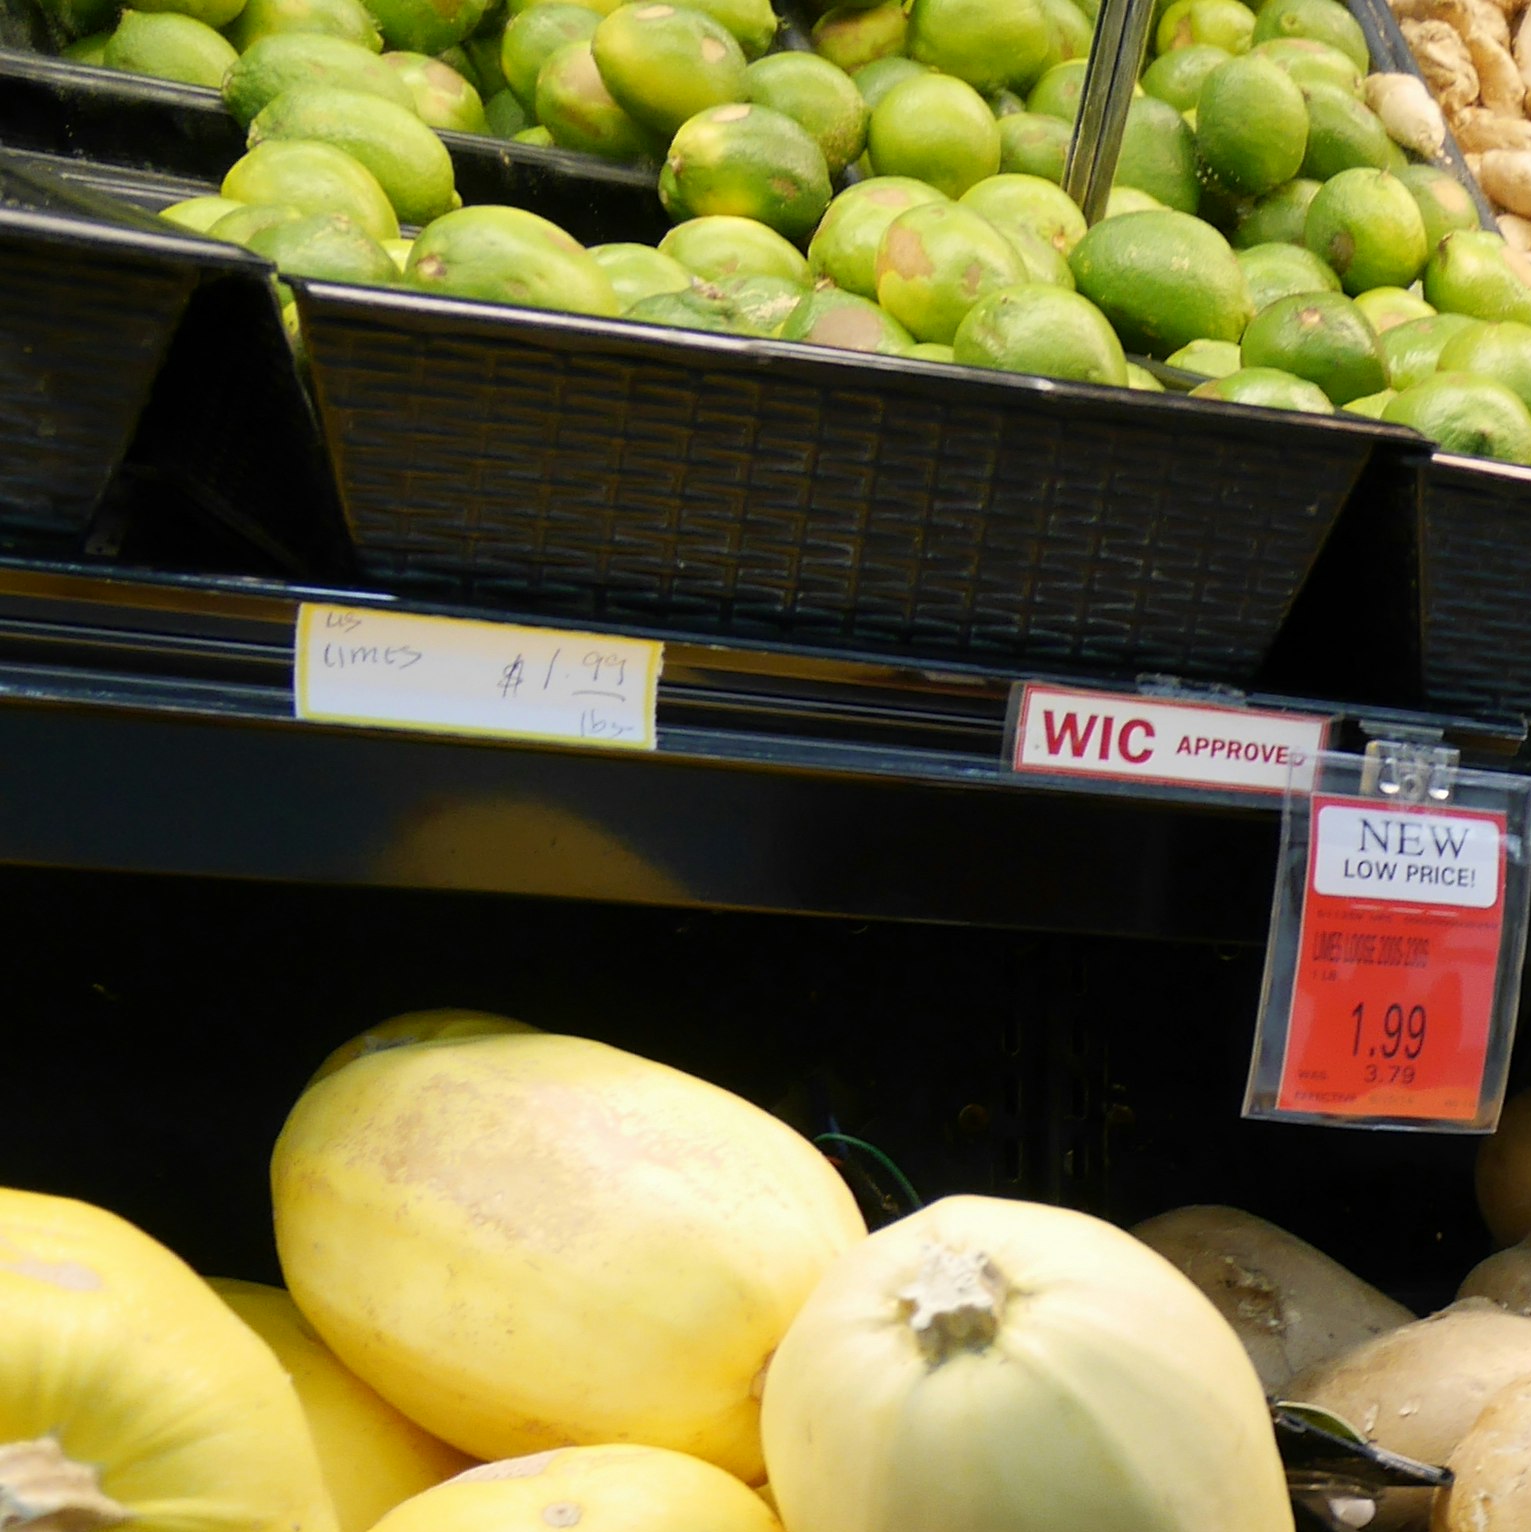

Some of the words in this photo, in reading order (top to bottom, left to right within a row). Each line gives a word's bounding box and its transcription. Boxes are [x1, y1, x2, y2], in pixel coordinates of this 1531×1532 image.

[1043, 710, 1155, 764] WIC
[1177, 736, 1308, 766] APPROVED
[1359, 818, 1470, 859] NEW
[1343, 860, 1397, 882] LOW
[1405, 865, 1477, 888] PRICE!
[1352, 1001, 1426, 1059] 1.99
[1364, 1065, 1416, 1084] 3.79
